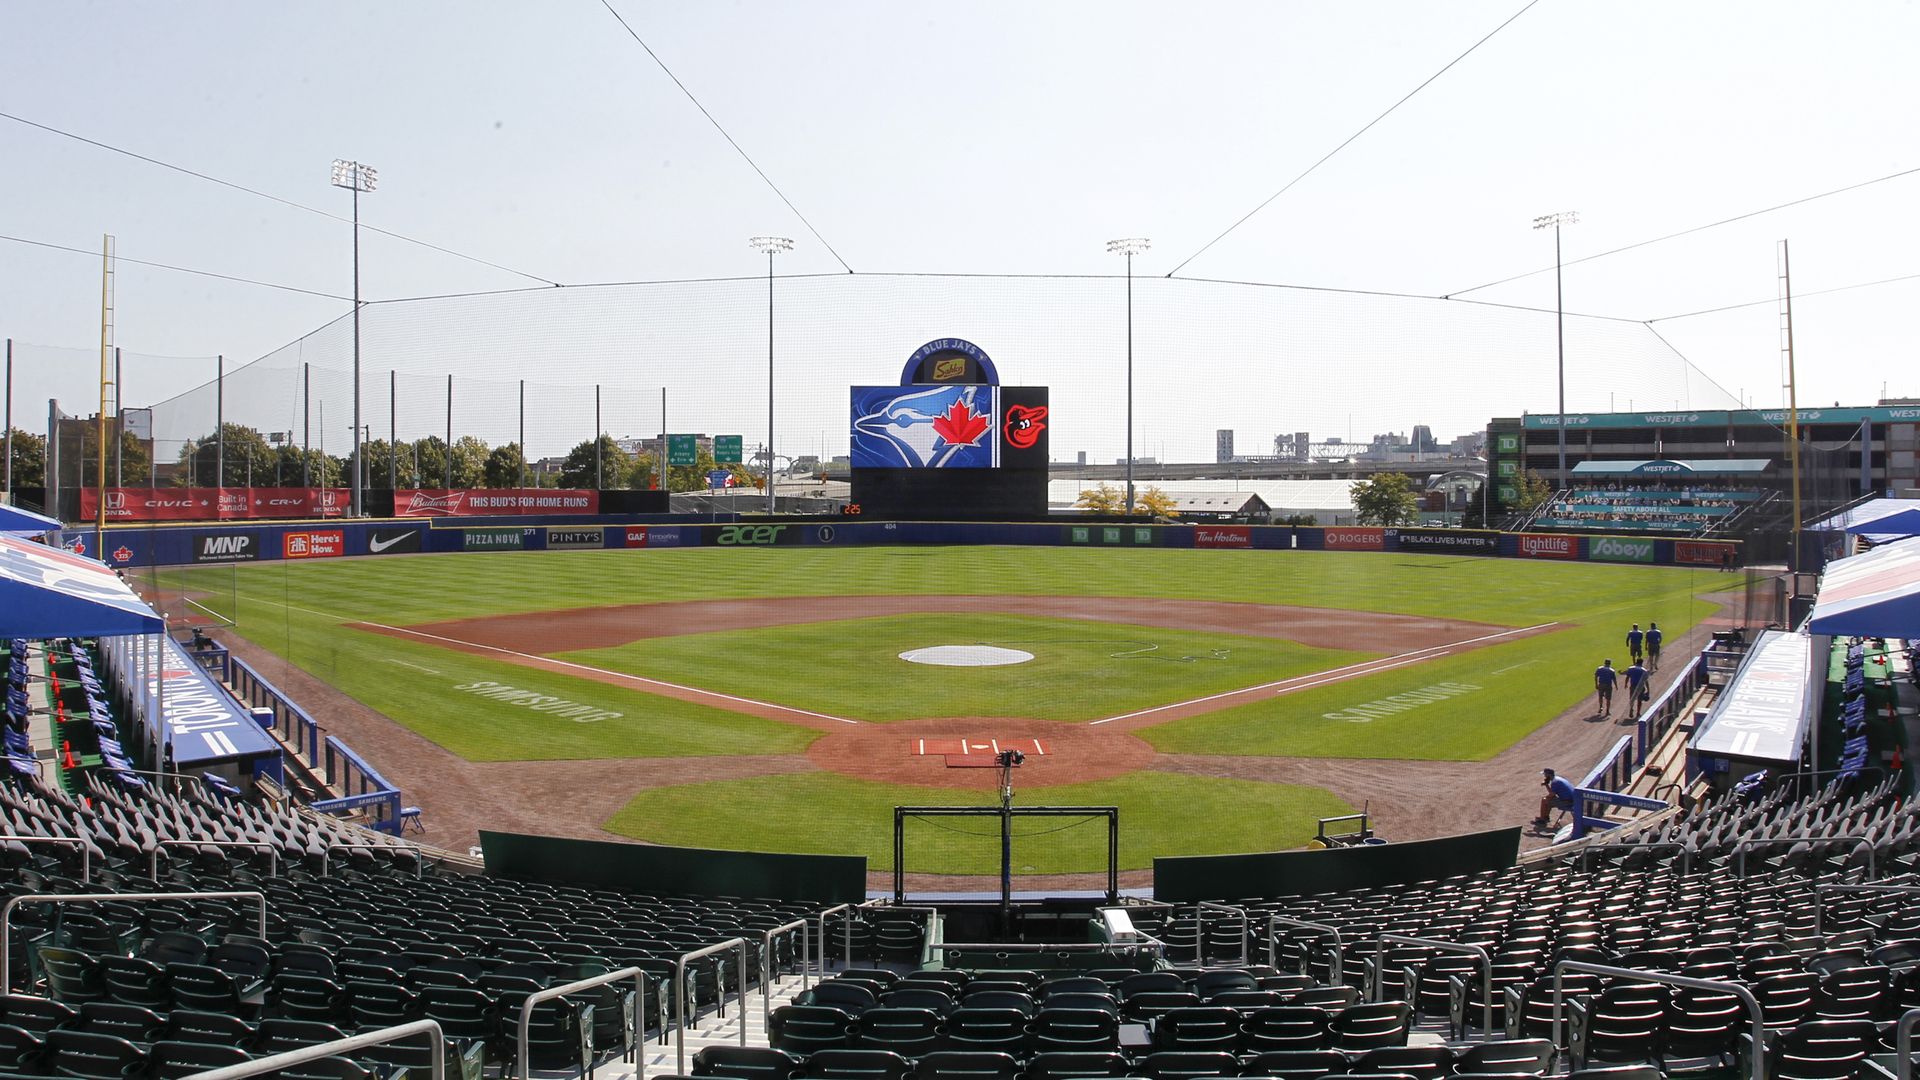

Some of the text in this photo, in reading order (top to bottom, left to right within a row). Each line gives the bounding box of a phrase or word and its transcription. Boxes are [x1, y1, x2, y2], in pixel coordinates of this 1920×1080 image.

[922, 339, 977, 355] BLUE JAYS
[1539, 416, 1578, 425] WESJET
[1645, 415, 1686, 424] WESTJET
[1762, 411, 1808, 420] WESTET
[1500, 438, 1516, 449] TD
[1500, 463, 1516, 474] TD
[1643, 465, 1673, 473] WESTJET
[144, 500, 193, 508] CIVIC
[218, 494, 247, 504] Built in
[269, 498, 303, 506] CR-V
[412, 496, 460, 510] Budweiser
[469, 497, 589, 508] THIS BUD'S FOR HOME RUNS
[216, 502, 248, 512] Canada
[523, 528, 536, 536] 371
[627, 532, 646, 541] GAF
[717, 525, 787, 545] acer
[1197, 531, 1248, 543] Tim Hortons
[310, 533, 340, 544] Here's
[465, 533, 520, 546] PIZZA NOVA
[552, 533, 600, 543] PINTY'S
[1339, 534, 1382, 544] ROGERS
[1410, 536, 1485, 546] BLACK LIVES MATTER
[203, 536, 250, 554] MNP
[310, 543, 335, 554] How.
[1522, 536, 1569, 556] Lightlife
[1592, 538, 1651, 558] Sobeys
[453, 681, 625, 724] SAMSUNG
[1322, 681, 1484, 724] SAMSUNG
[358, 795, 387, 806] SAMSUNG
[1582, 792, 1614, 803] SAMSUNG
